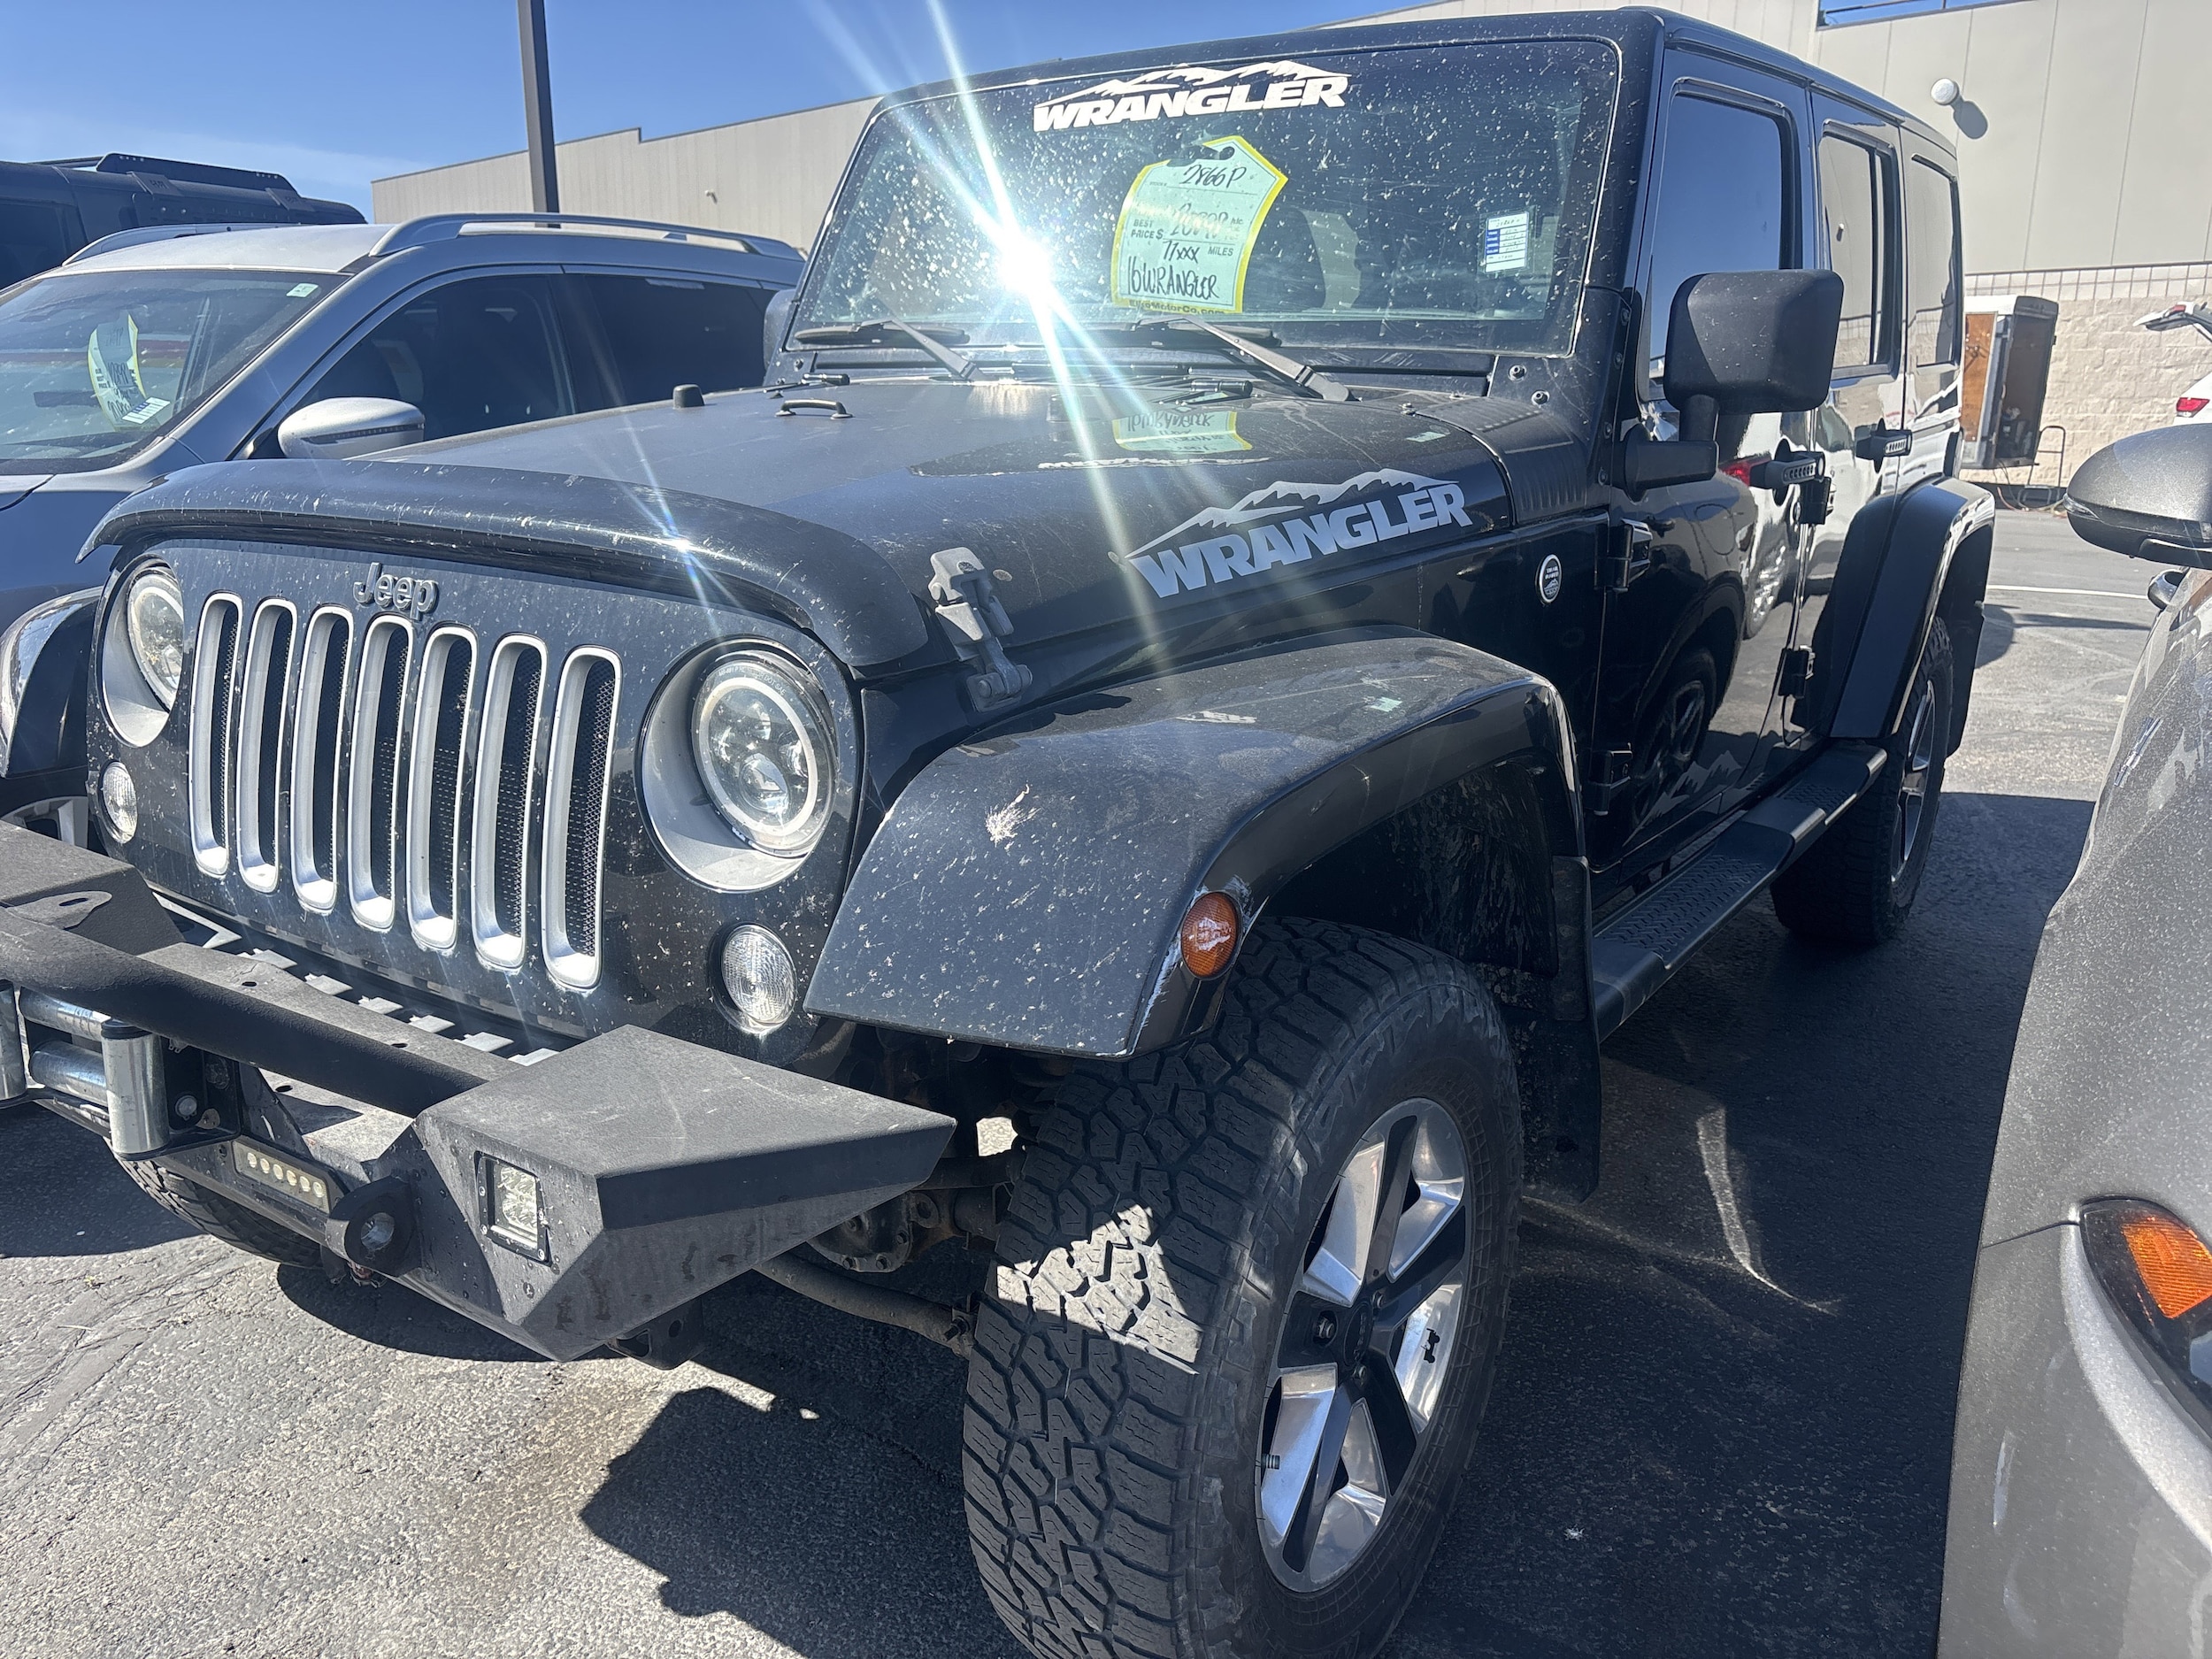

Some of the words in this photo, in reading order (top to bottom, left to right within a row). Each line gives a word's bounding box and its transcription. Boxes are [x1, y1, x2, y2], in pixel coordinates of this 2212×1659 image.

[1033, 77, 1348, 132] WRANGLER
[1131, 228, 1155, 238] PRICE
[1133, 219, 1154, 228] BEST
[1208, 246, 1234, 257] MILES
[1128, 482, 1472, 598] WRANGLER
[353, 562, 440, 620] Jeep
